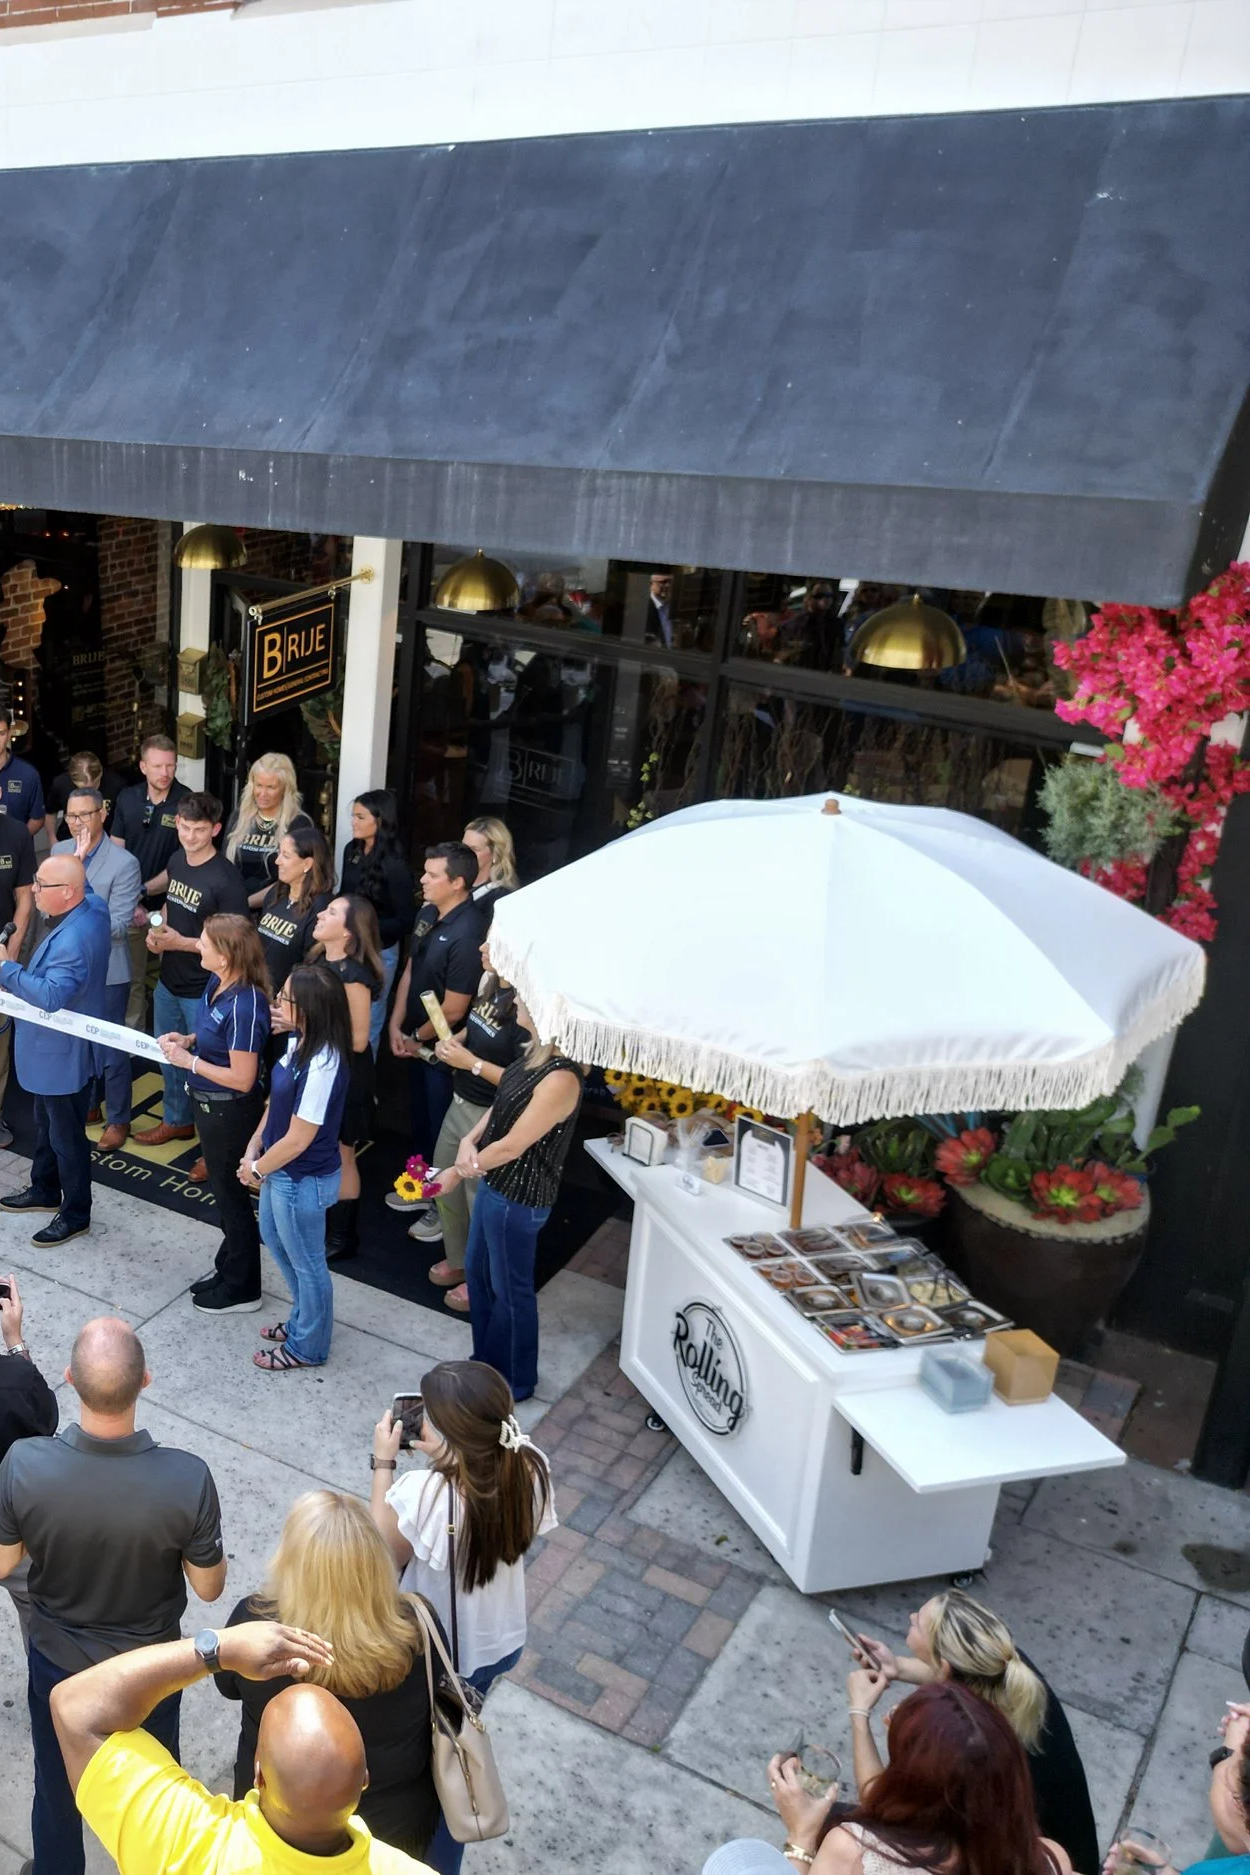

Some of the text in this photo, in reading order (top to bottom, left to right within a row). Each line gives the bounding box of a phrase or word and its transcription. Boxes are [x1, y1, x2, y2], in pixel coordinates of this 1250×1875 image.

[168, 879, 202, 906] BRIJE
[260, 912, 298, 939] BRIJE
[90, 1150, 152, 1181] stom
[706, 1317, 722, 1350] The
[673, 1311, 743, 1432] Rolling
